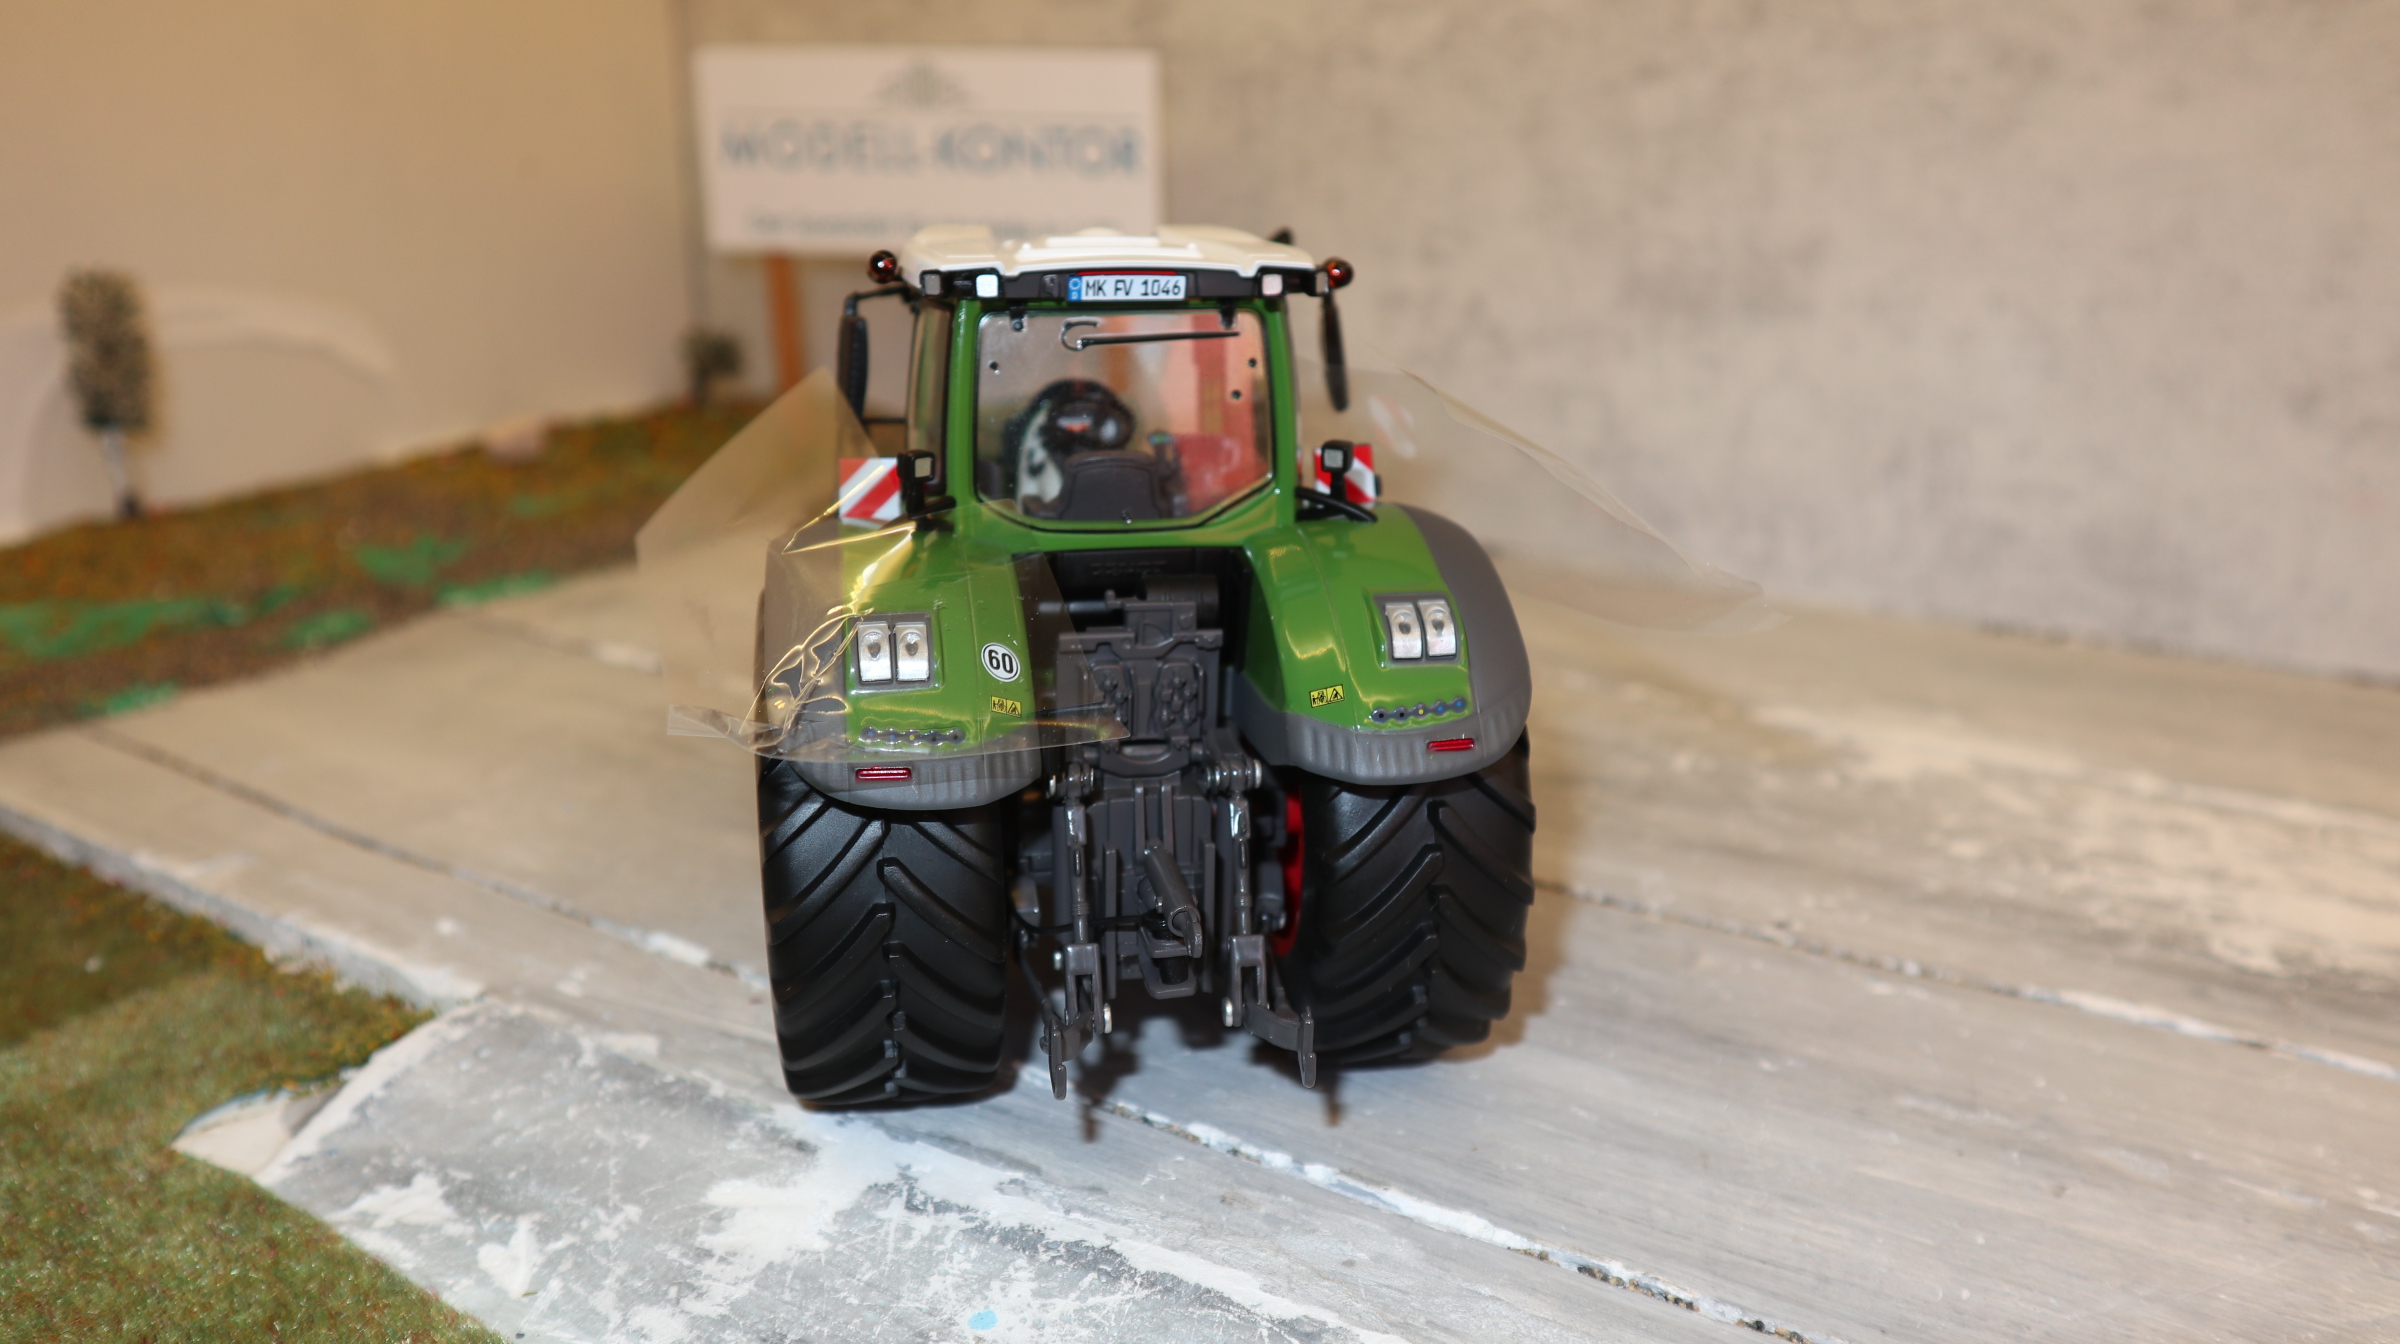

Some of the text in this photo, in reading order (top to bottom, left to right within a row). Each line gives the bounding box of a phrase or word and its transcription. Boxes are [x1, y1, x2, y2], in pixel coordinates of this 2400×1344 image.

[1085, 279, 1107, 297] MK
[1114, 279, 1133, 297] FV
[1141, 279, 1181, 297] 1046
[988, 649, 1014, 674] 60
